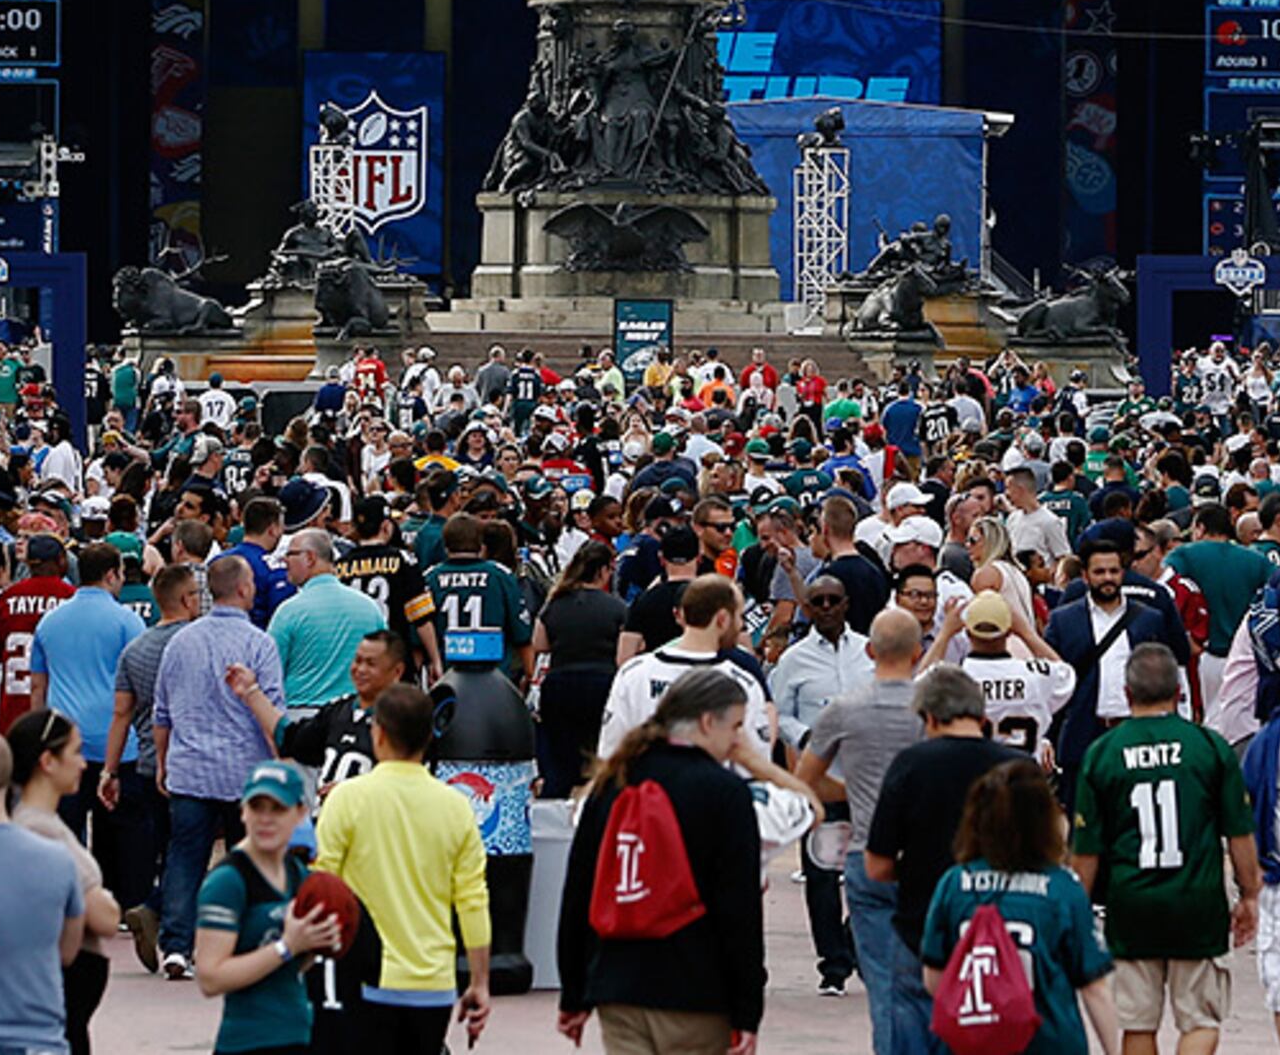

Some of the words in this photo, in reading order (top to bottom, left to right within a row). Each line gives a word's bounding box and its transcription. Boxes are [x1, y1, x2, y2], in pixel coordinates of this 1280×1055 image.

[1216, 56, 1258, 68] ROUND
[722, 75, 910, 102] TURE
[518, 380, 533, 400] 11
[207, 400, 226, 417] 17
[926, 416, 949, 442] 20
[334, 557, 400, 578] OLAMALU
[438, 573, 487, 587] WENTZ
[441, 595, 482, 631] 11
[983, 681, 1025, 700] RTER
[1123, 743, 1182, 769] WENTZ
[1130, 780, 1183, 868] 11
